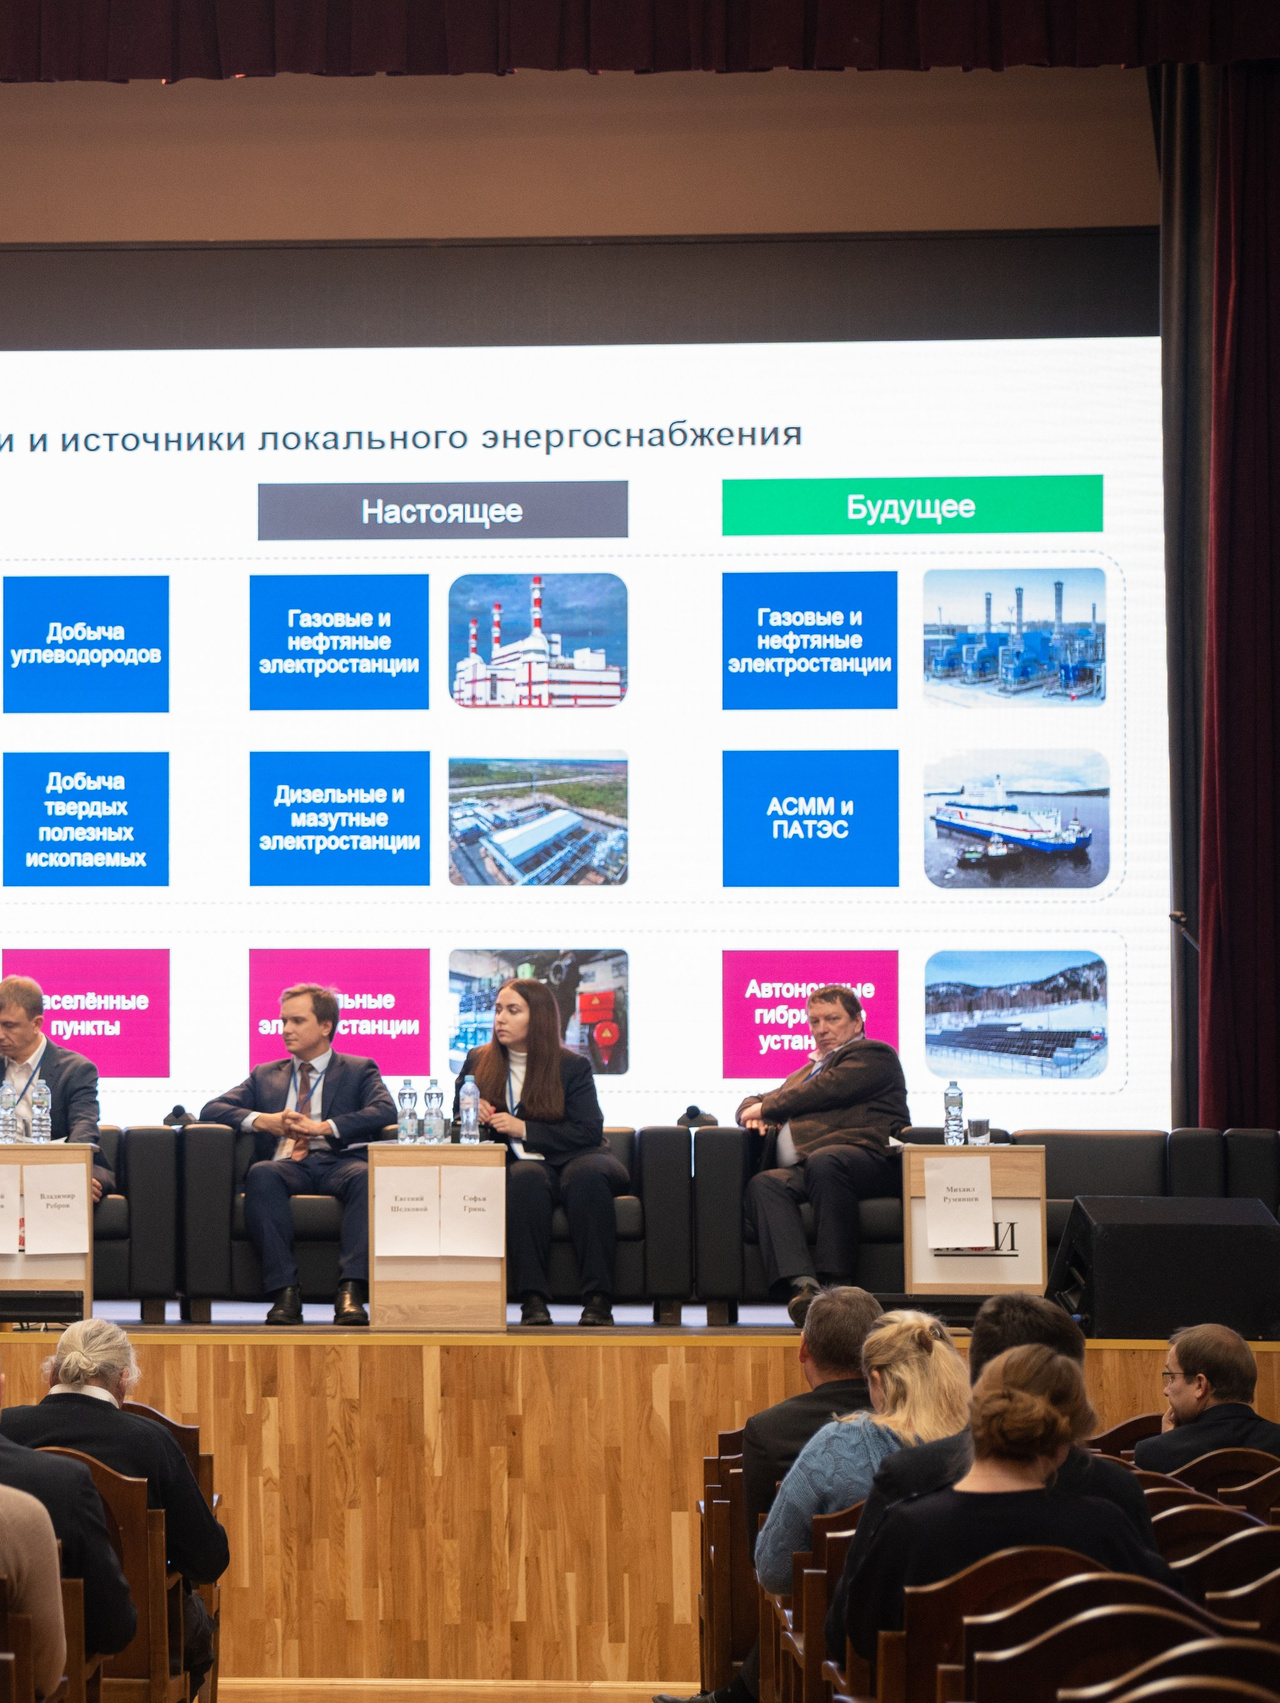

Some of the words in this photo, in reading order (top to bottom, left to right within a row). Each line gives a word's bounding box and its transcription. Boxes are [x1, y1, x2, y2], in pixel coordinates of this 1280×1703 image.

[29, 433, 48, 453] и
[61, 431, 245, 453] источники
[257, 430, 469, 451] локального
[481, 419, 802, 455] энергоснабжения
[362, 498, 524, 530] Настоящее
[848, 494, 976, 526] Будущее
[288, 608, 374, 628] Газовые
[378, 612, 391, 627] и
[757, 607, 843, 627] Газовые
[849, 610, 863, 626] и
[46, 622, 125, 645] Добыча
[288, 632, 392, 653] нефтяные
[757, 632, 863, 652] нефтяные
[10, 648, 162, 668] углеводородов
[259, 657, 420, 678] электростанции
[728, 656, 892, 677] электростанции
[46, 771, 126, 795] Добыча
[274, 784, 387, 806] Дизельные
[391, 788, 405, 803] и
[43, 798, 129, 820] твердых
[766, 796, 835, 816] АСММ
[840, 800, 854, 816] и
[291, 811, 389, 831] мазутные
[772, 819, 849, 839] ПАТЭС
[38, 825, 135, 843] полезных
[259, 834, 421, 855] электростанции
[25, 852, 147, 868] ископаемых
[745, 979, 875, 998] Автоноые
[42, 992, 149, 1010] аселённые
[51, 1020, 121, 1040] пункты
[258, 1019, 420, 1039] элстанции
[758, 1034, 817, 1055] устан
